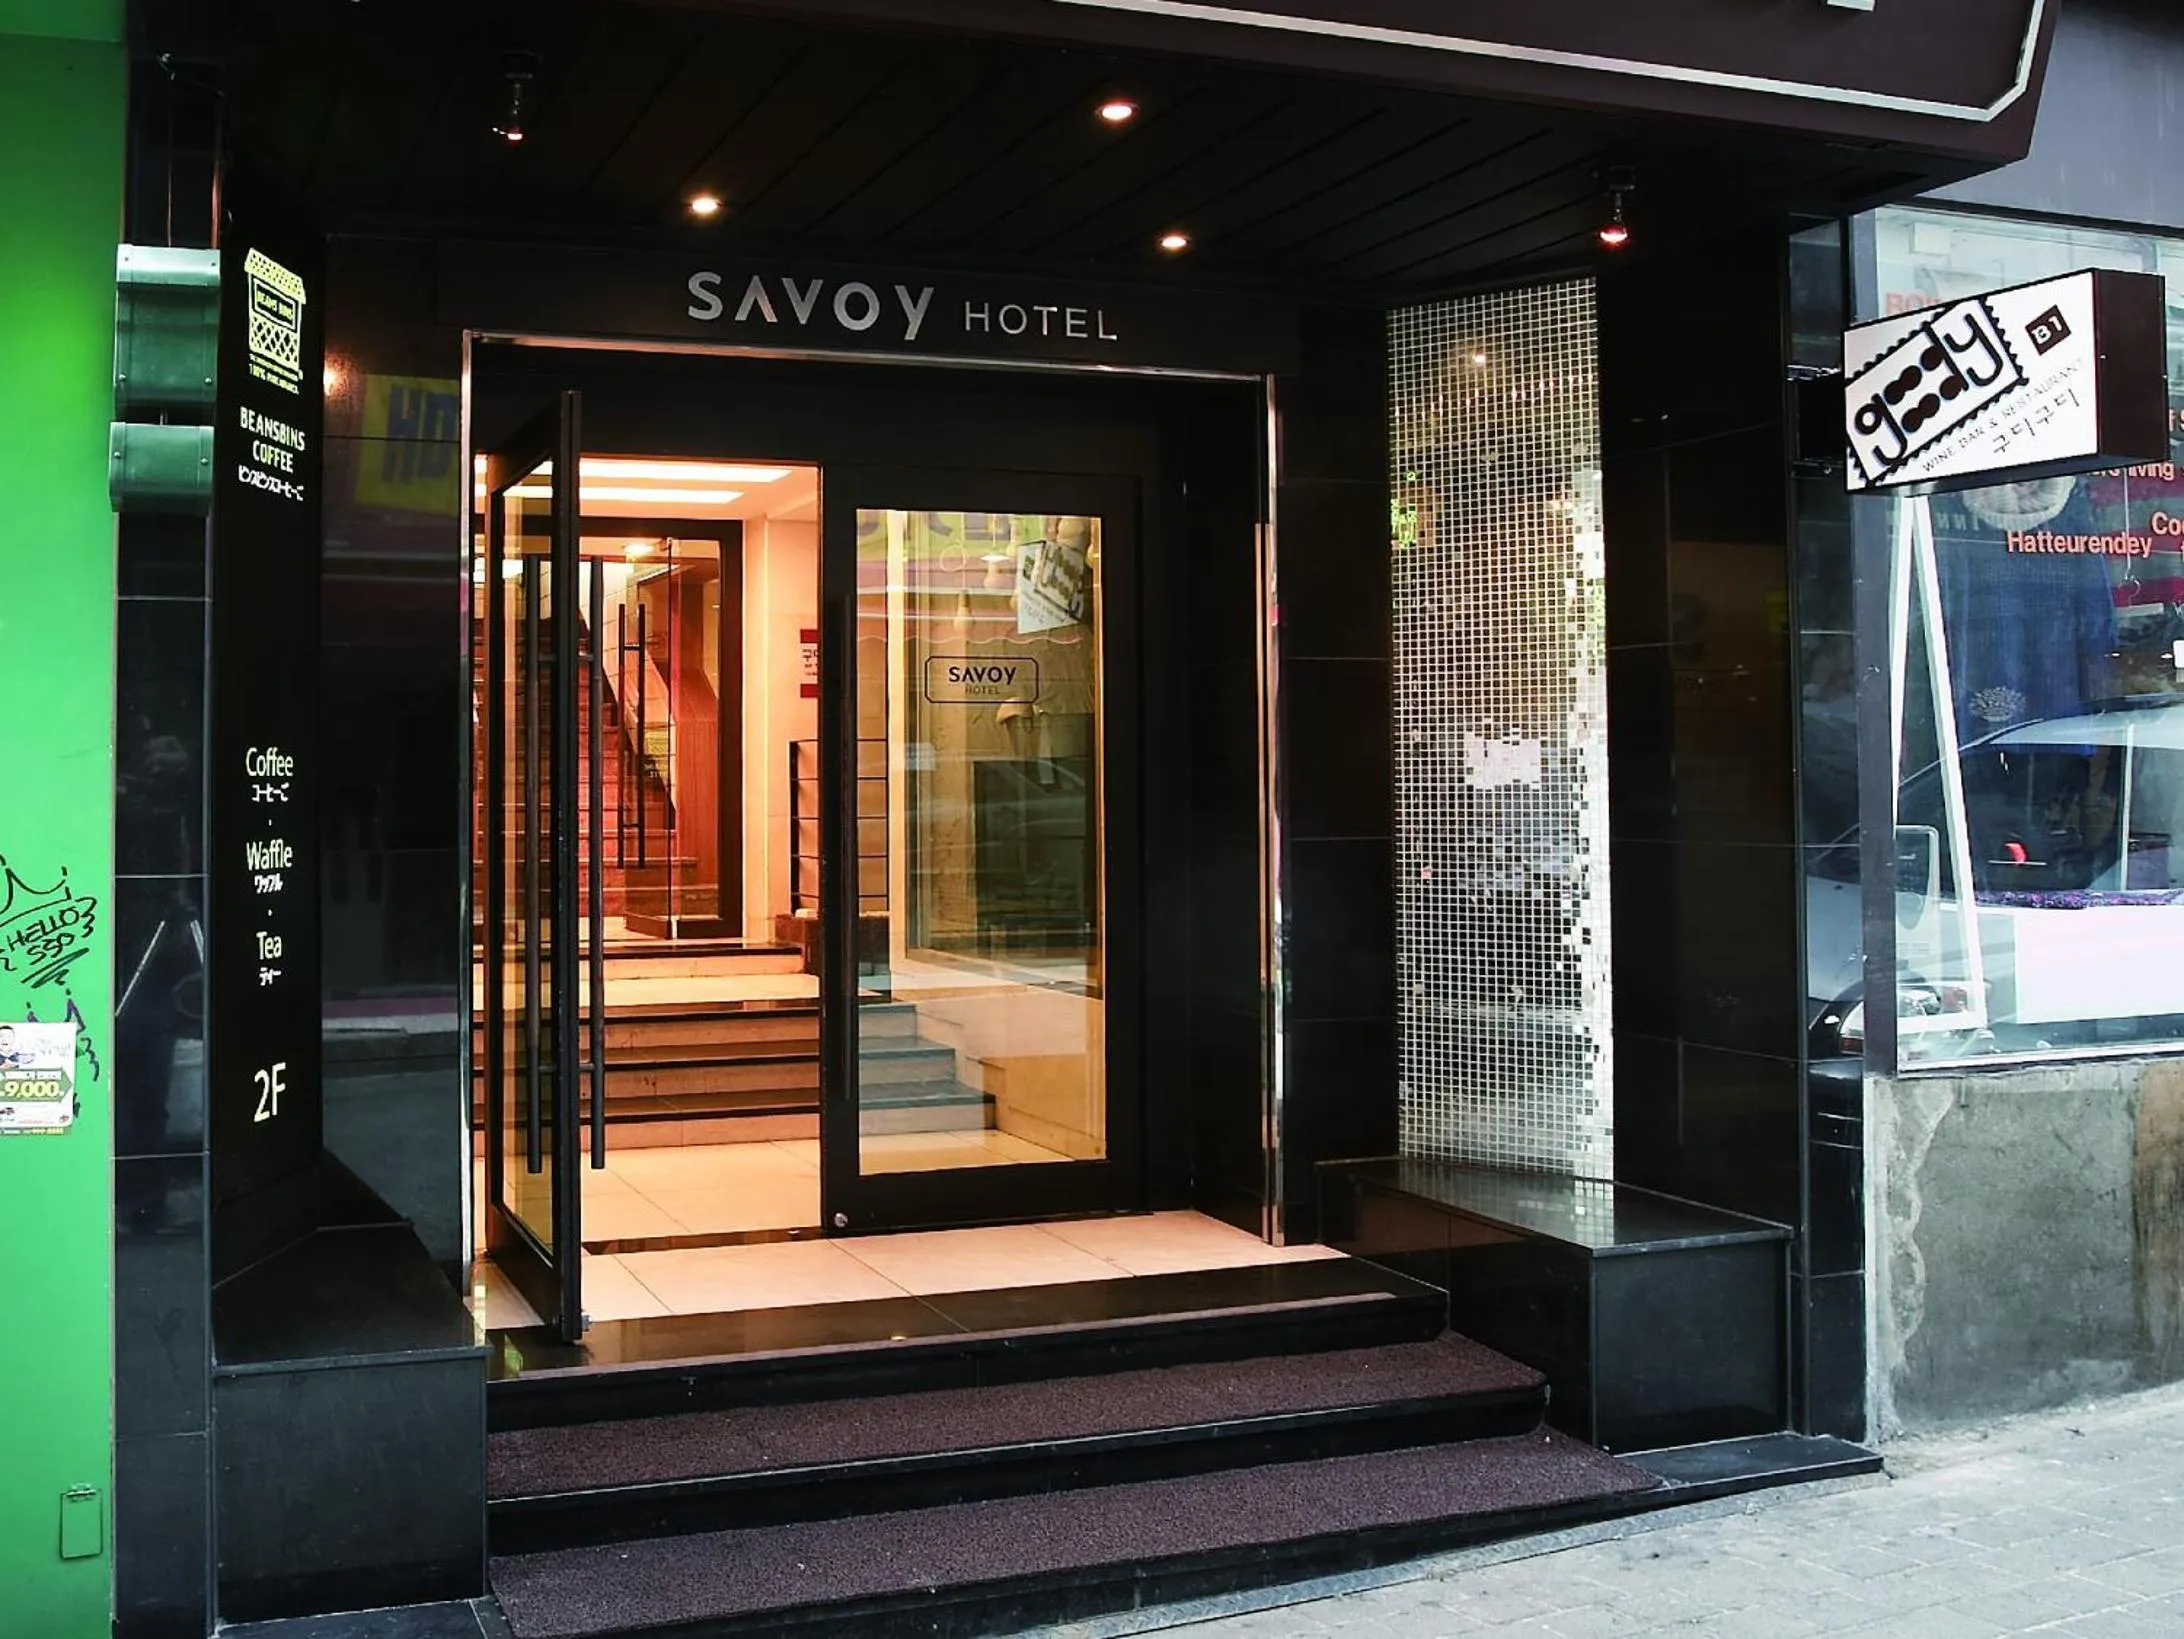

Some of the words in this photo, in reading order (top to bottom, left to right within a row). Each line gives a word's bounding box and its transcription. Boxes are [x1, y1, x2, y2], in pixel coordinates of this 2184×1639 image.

[688, 271, 934, 340] SAVOY
[965, 301, 1117, 340] HOTEL
[2031, 315, 2062, 345] B1
[240, 406, 305, 451] BEANSBINS
[1993, 388, 2080, 453] 구디구디
[253, 440, 293, 473] COFFEE
[1922, 447, 1954, 472] WINE
[2007, 530, 2152, 558] Hatteurendey
[949, 666, 1016, 686] SAVOY
[965, 685, 1000, 695] HOTEL
[246, 747, 293, 777] Coffee
[246, 838, 293, 871] Waffle
[6, 906, 80, 952] HELLO
[256, 931, 282, 960] Tea
[4, 1081, 60, 1098] 9,000
[254, 1061, 286, 1122] 2F
